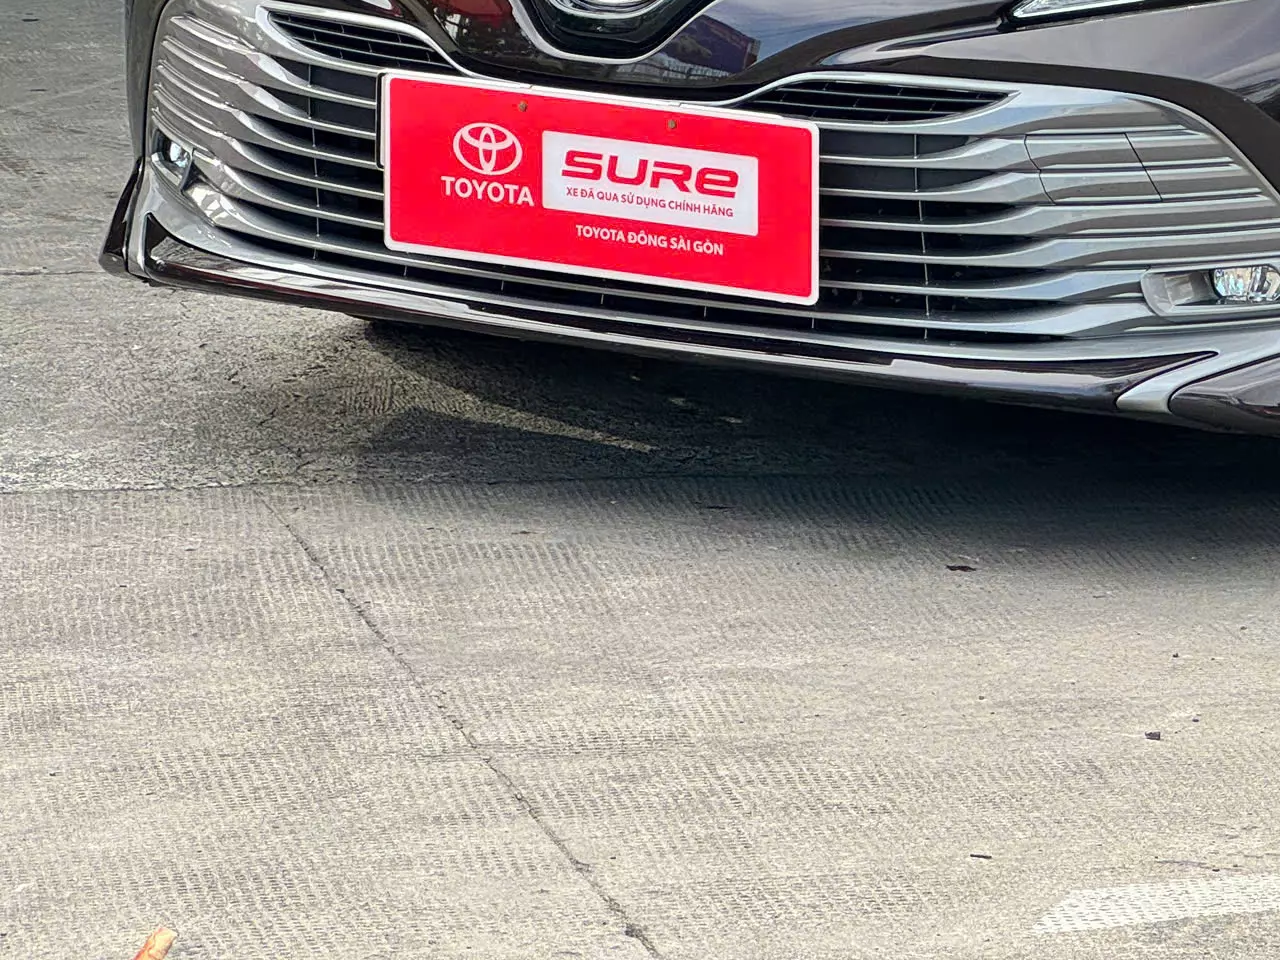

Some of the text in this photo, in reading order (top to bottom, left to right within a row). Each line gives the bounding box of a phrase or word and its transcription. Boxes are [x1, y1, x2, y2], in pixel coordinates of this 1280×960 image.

[440, 175, 535, 207] TOYOTA
[566, 186, 734, 218] XE ĐÃ QUA SỬ DỤNG CHÍNH HÃNG
[575, 224, 724, 256] TOYOTA ĐÔNG SÀI GÒN
